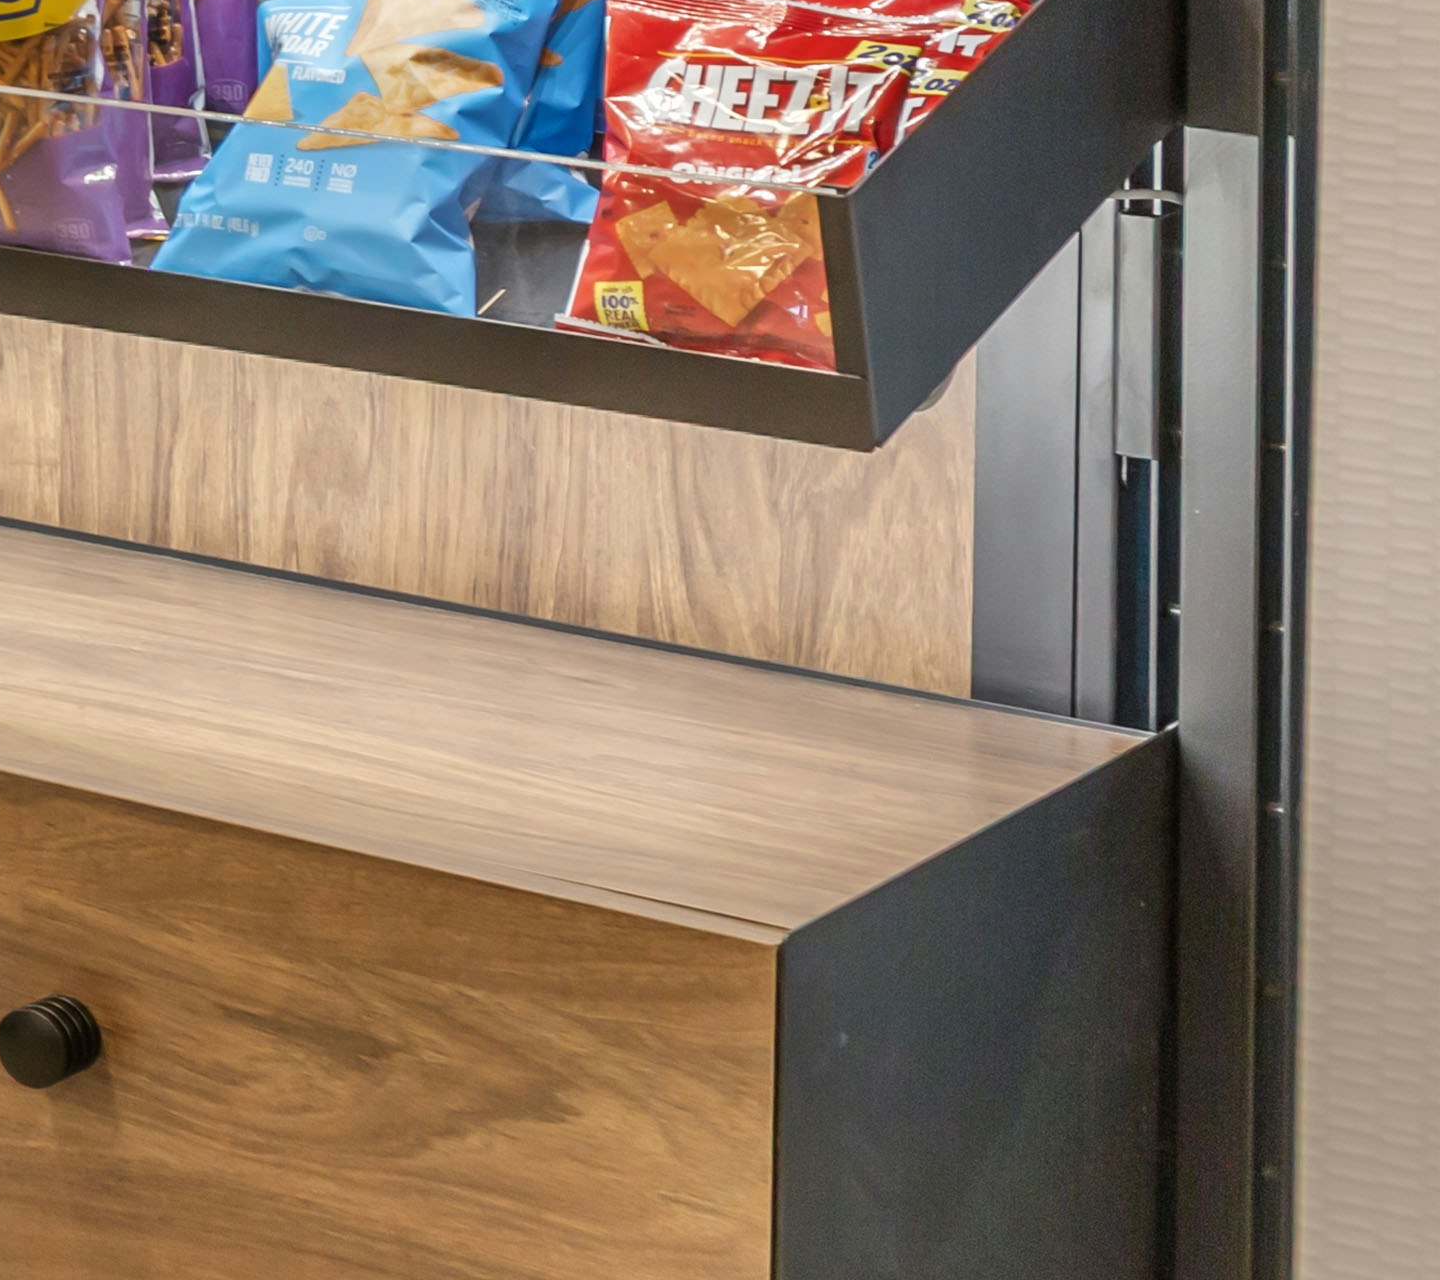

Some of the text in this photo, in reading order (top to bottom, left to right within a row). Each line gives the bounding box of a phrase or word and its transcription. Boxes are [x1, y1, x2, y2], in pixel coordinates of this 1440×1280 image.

[284, 156, 314, 177] 240
[600, 294, 638, 309] 100%
[604, 310, 637, 325] REAL
